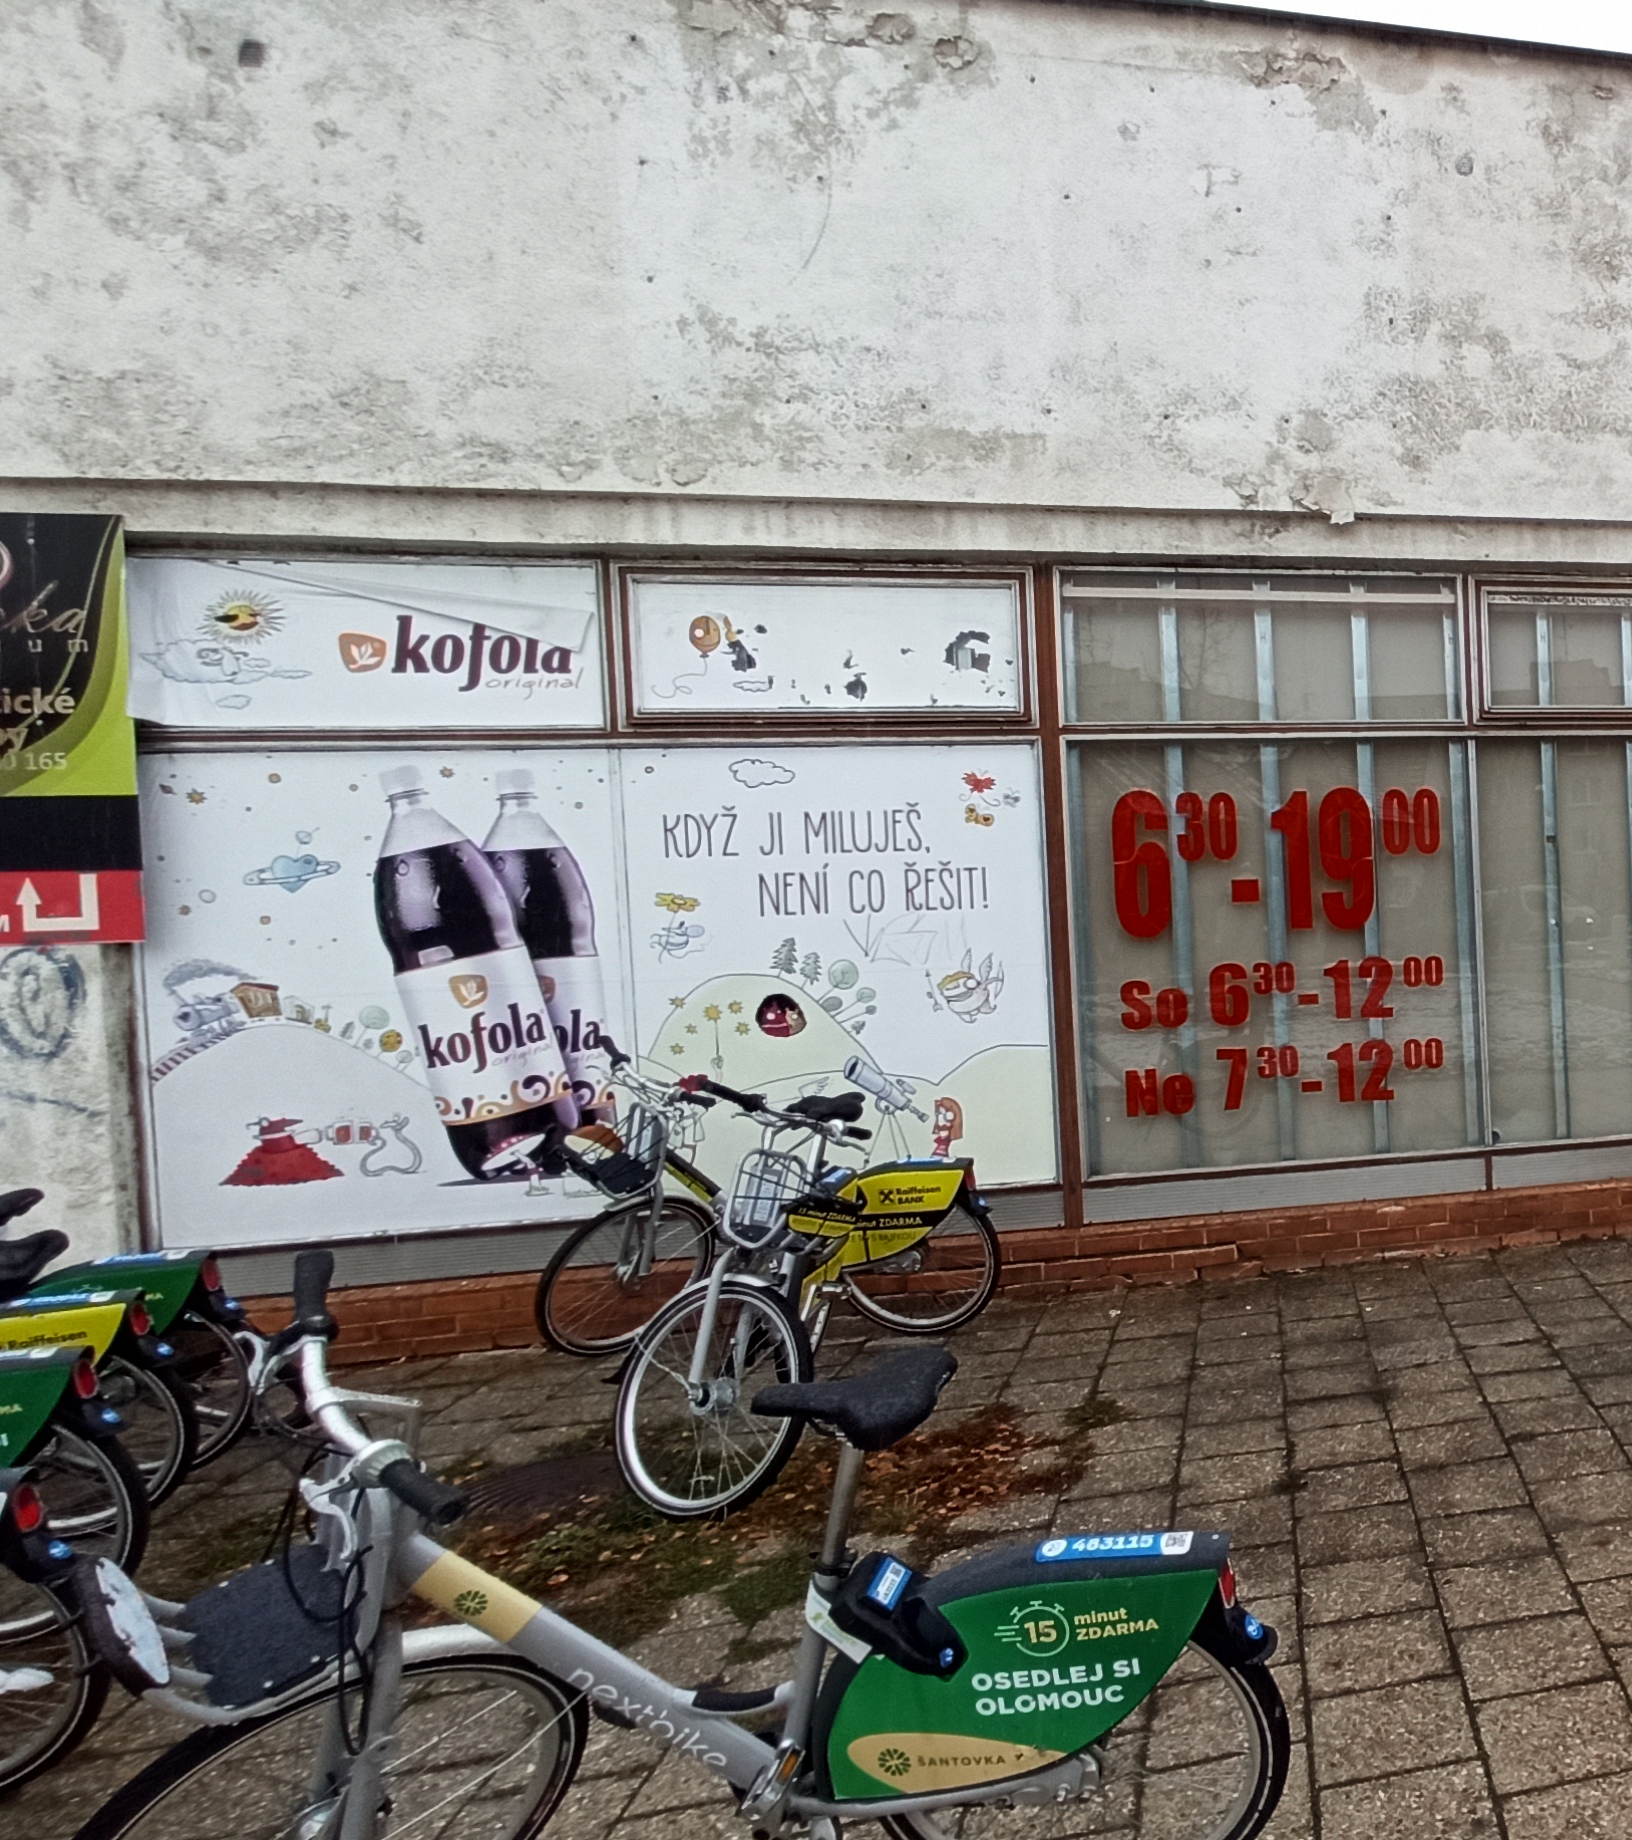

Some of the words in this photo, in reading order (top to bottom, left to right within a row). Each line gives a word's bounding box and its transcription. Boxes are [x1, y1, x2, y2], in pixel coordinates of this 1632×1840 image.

[391, 615, 572, 692] kofola
[485, 667, 584, 700] original
[0, 687, 76, 715] ické
[25, 753, 68, 771] 165
[662, 805, 740, 858] KDYŽ
[759, 812, 783, 856] JI
[804, 802, 931, 855] MILUJEŠ,
[758, 862, 829, 917] NENÍ
[848, 869, 886, 914] CO
[904, 860, 990, 912] ŘEŠIT!
[1120, 980, 1188, 1030] So
[418, 1003, 546, 1073] kofola
[1125, 1068, 1195, 1117] Ne
[879, 1217, 923, 1228] ZDARMA
[7, 1330, 87, 1349] Raiffeisen
[1024, 1620, 1057, 1644] 15
[1074, 1607, 1128, 1625] minut
[1076, 1618, 1159, 1641] ZDARMA
[971, 1663, 1103, 1692] OSEDLEJ
[1112, 1658, 1141, 1678] SI
[975, 1685, 1124, 1716] OLOMOUC
[917, 1755, 1006, 1768] ŠANTOVKA
